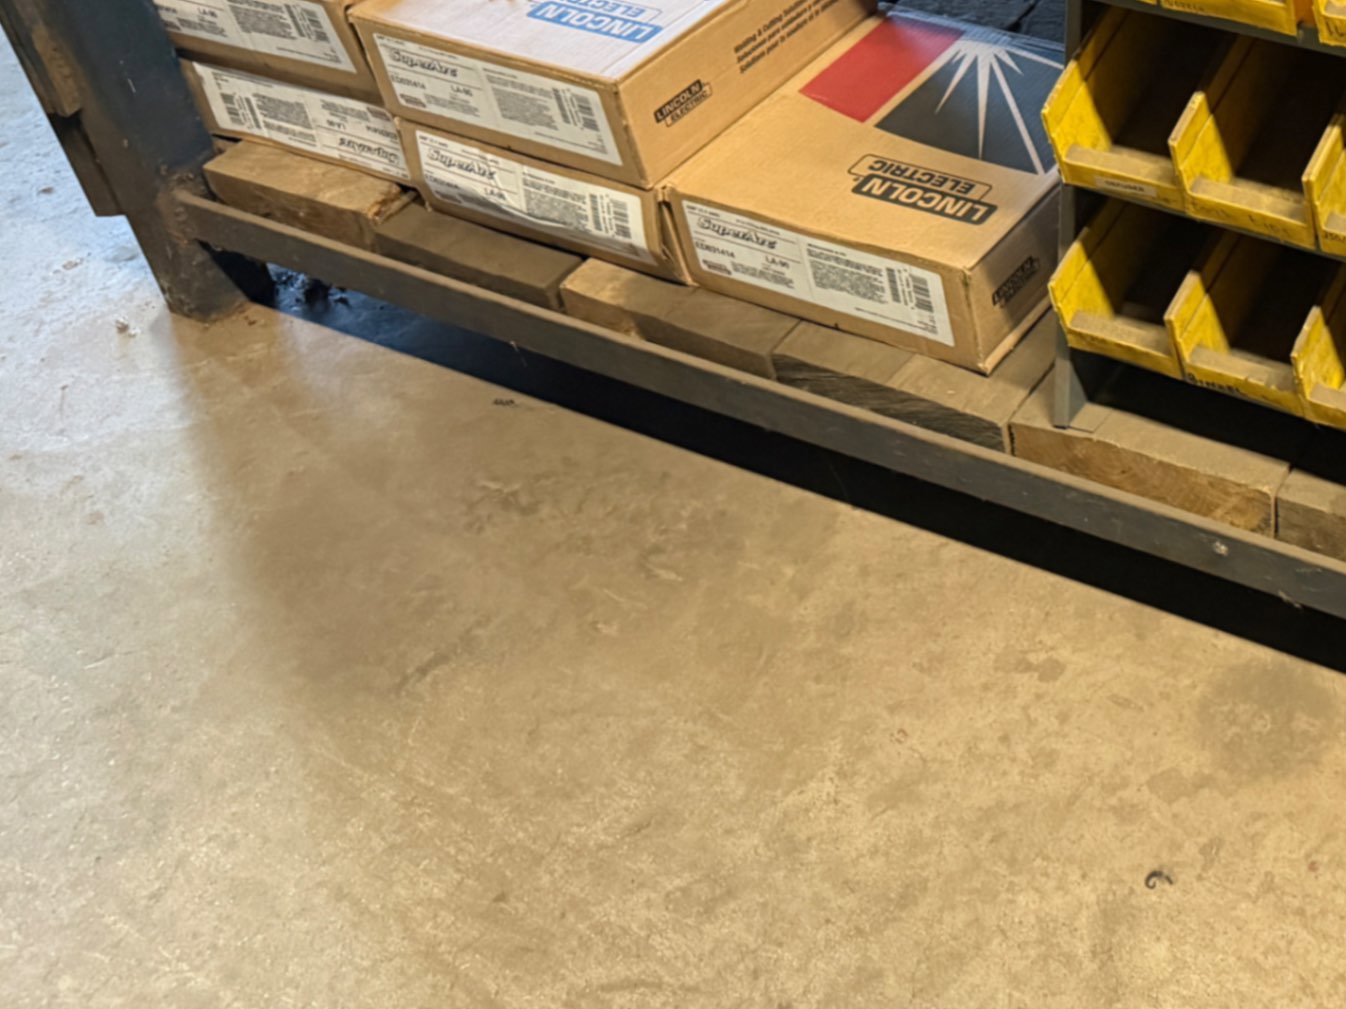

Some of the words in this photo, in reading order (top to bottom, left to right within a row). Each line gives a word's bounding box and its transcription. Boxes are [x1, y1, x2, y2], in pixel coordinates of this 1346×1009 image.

[535, 3, 655, 41] LINCOLN
[655, 82, 702, 121] LINCOLN
[867, 159, 977, 195] ELECTRIC
[860, 177, 989, 222] LINCOLN
